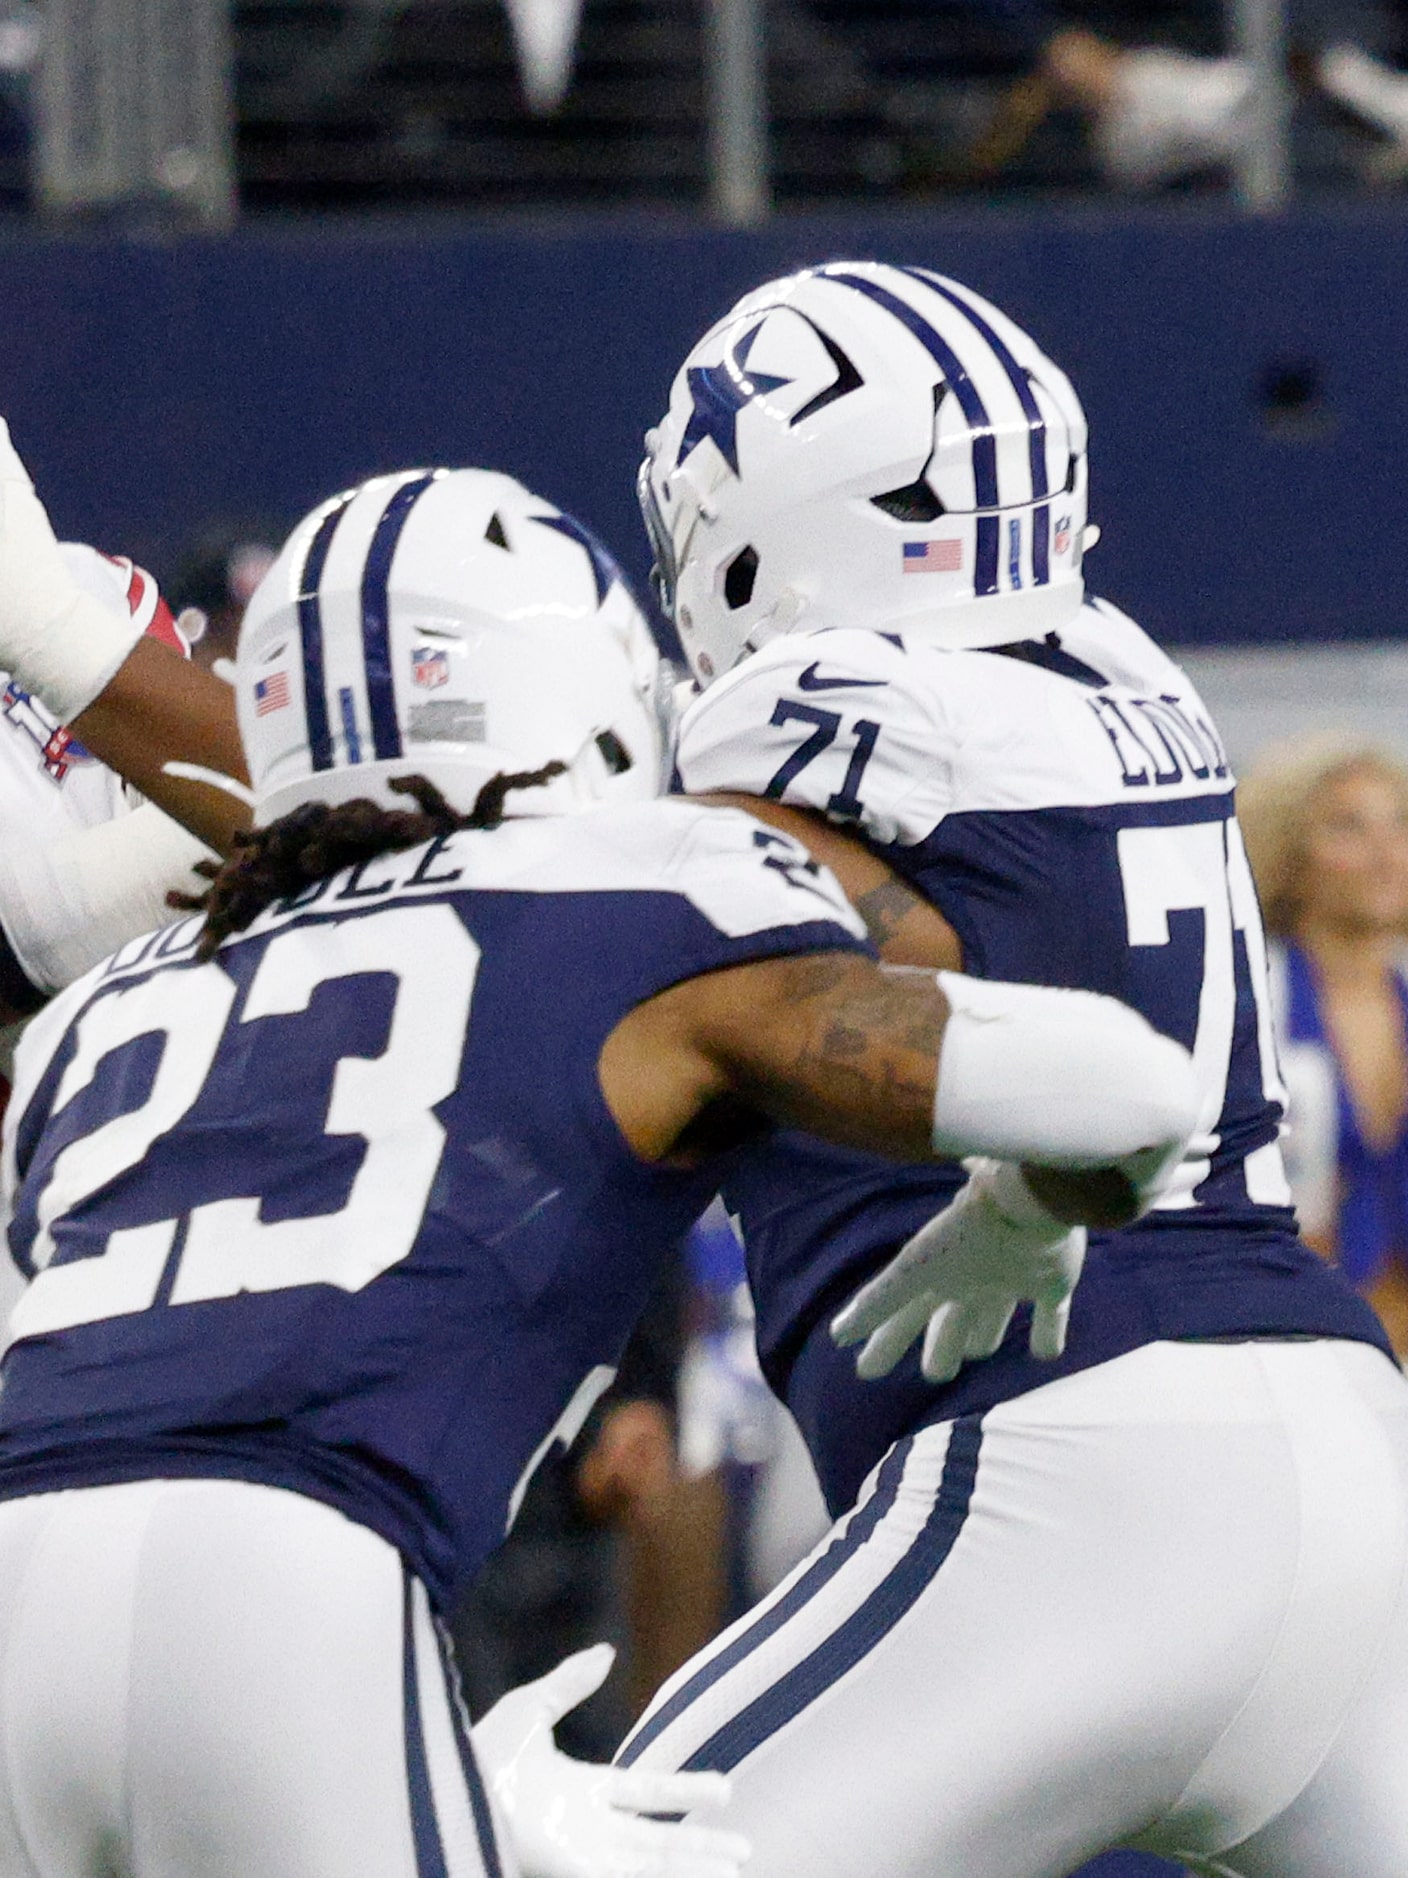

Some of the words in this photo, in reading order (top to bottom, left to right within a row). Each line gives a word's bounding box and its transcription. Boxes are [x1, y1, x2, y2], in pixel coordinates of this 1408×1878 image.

[769, 698, 881, 822] 71
[4, 902, 482, 1345] 23
[1117, 816, 1292, 1208] 71
